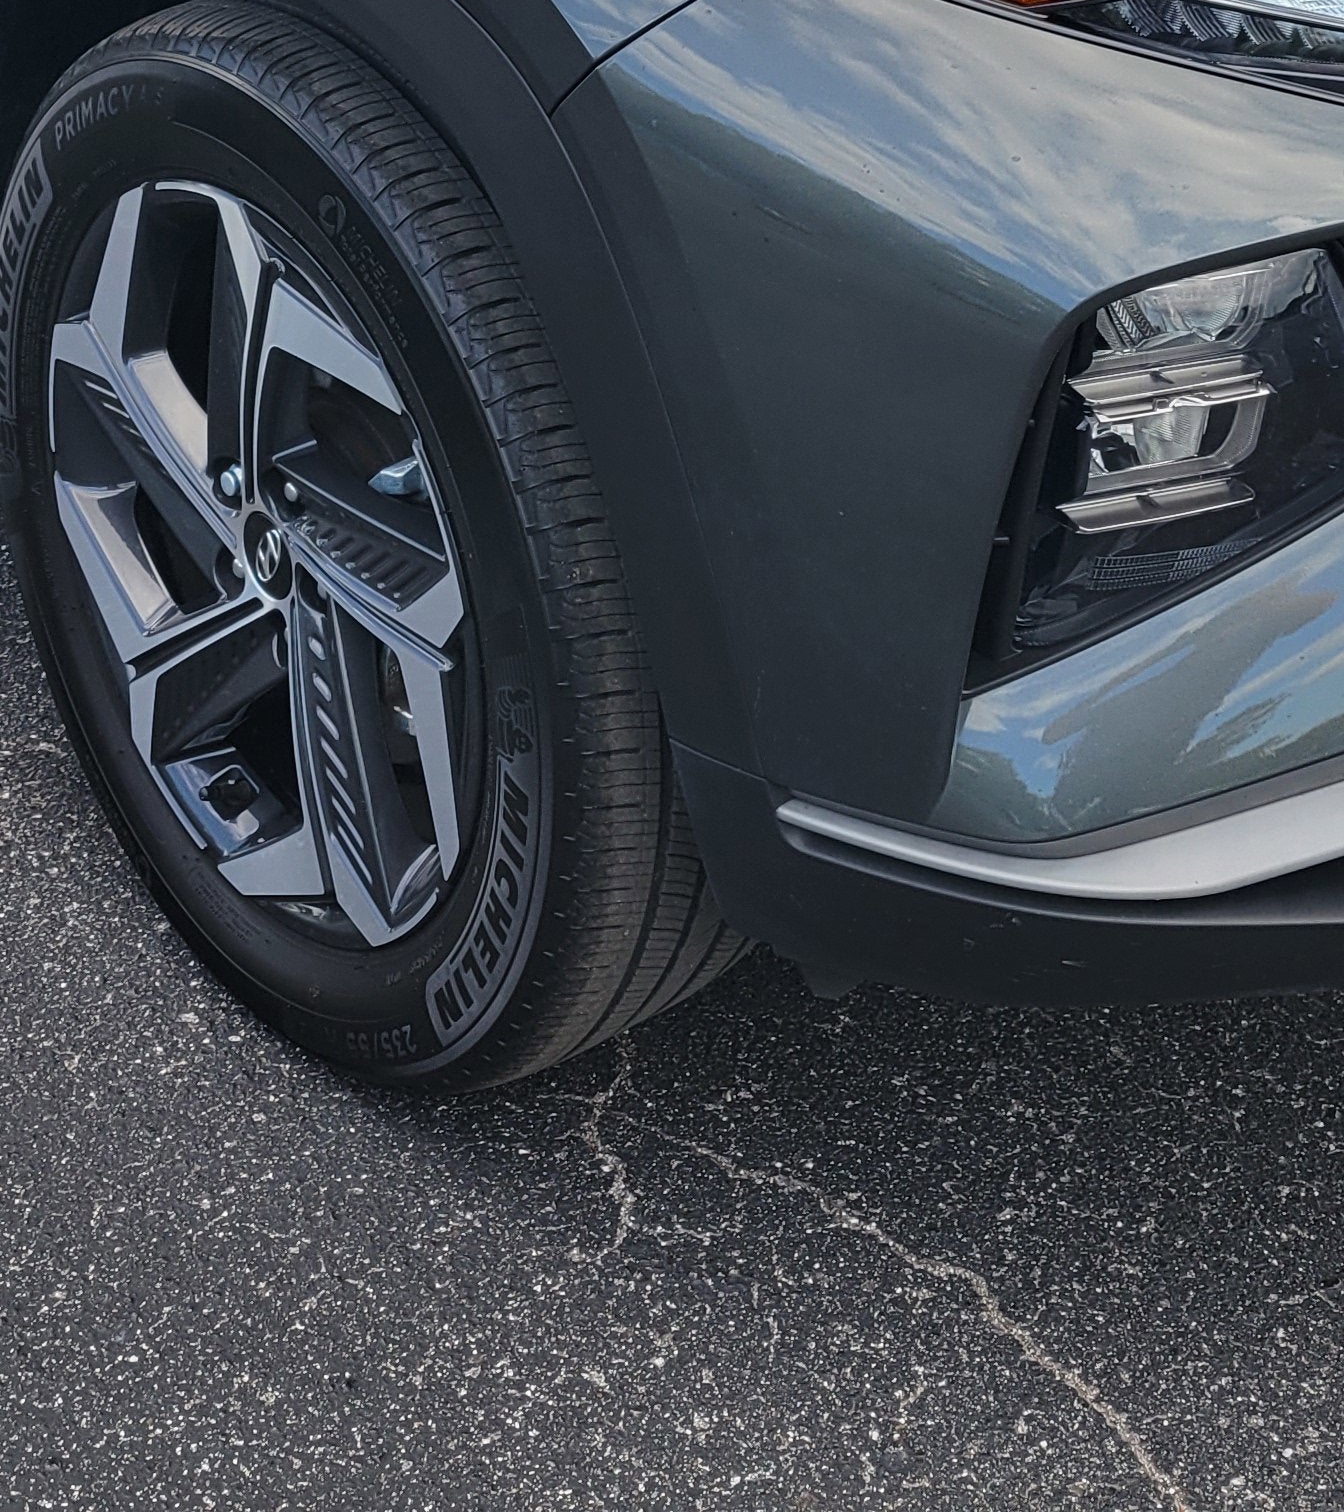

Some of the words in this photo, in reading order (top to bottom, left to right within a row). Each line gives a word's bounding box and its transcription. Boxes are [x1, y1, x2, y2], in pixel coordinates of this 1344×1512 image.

[54, 84, 134, 152] PRIMACY
[346, 225, 402, 308] MICHELIN
[434, 769, 530, 1032] MICHELIN
[346, 1025, 417, 1061] 235/55
